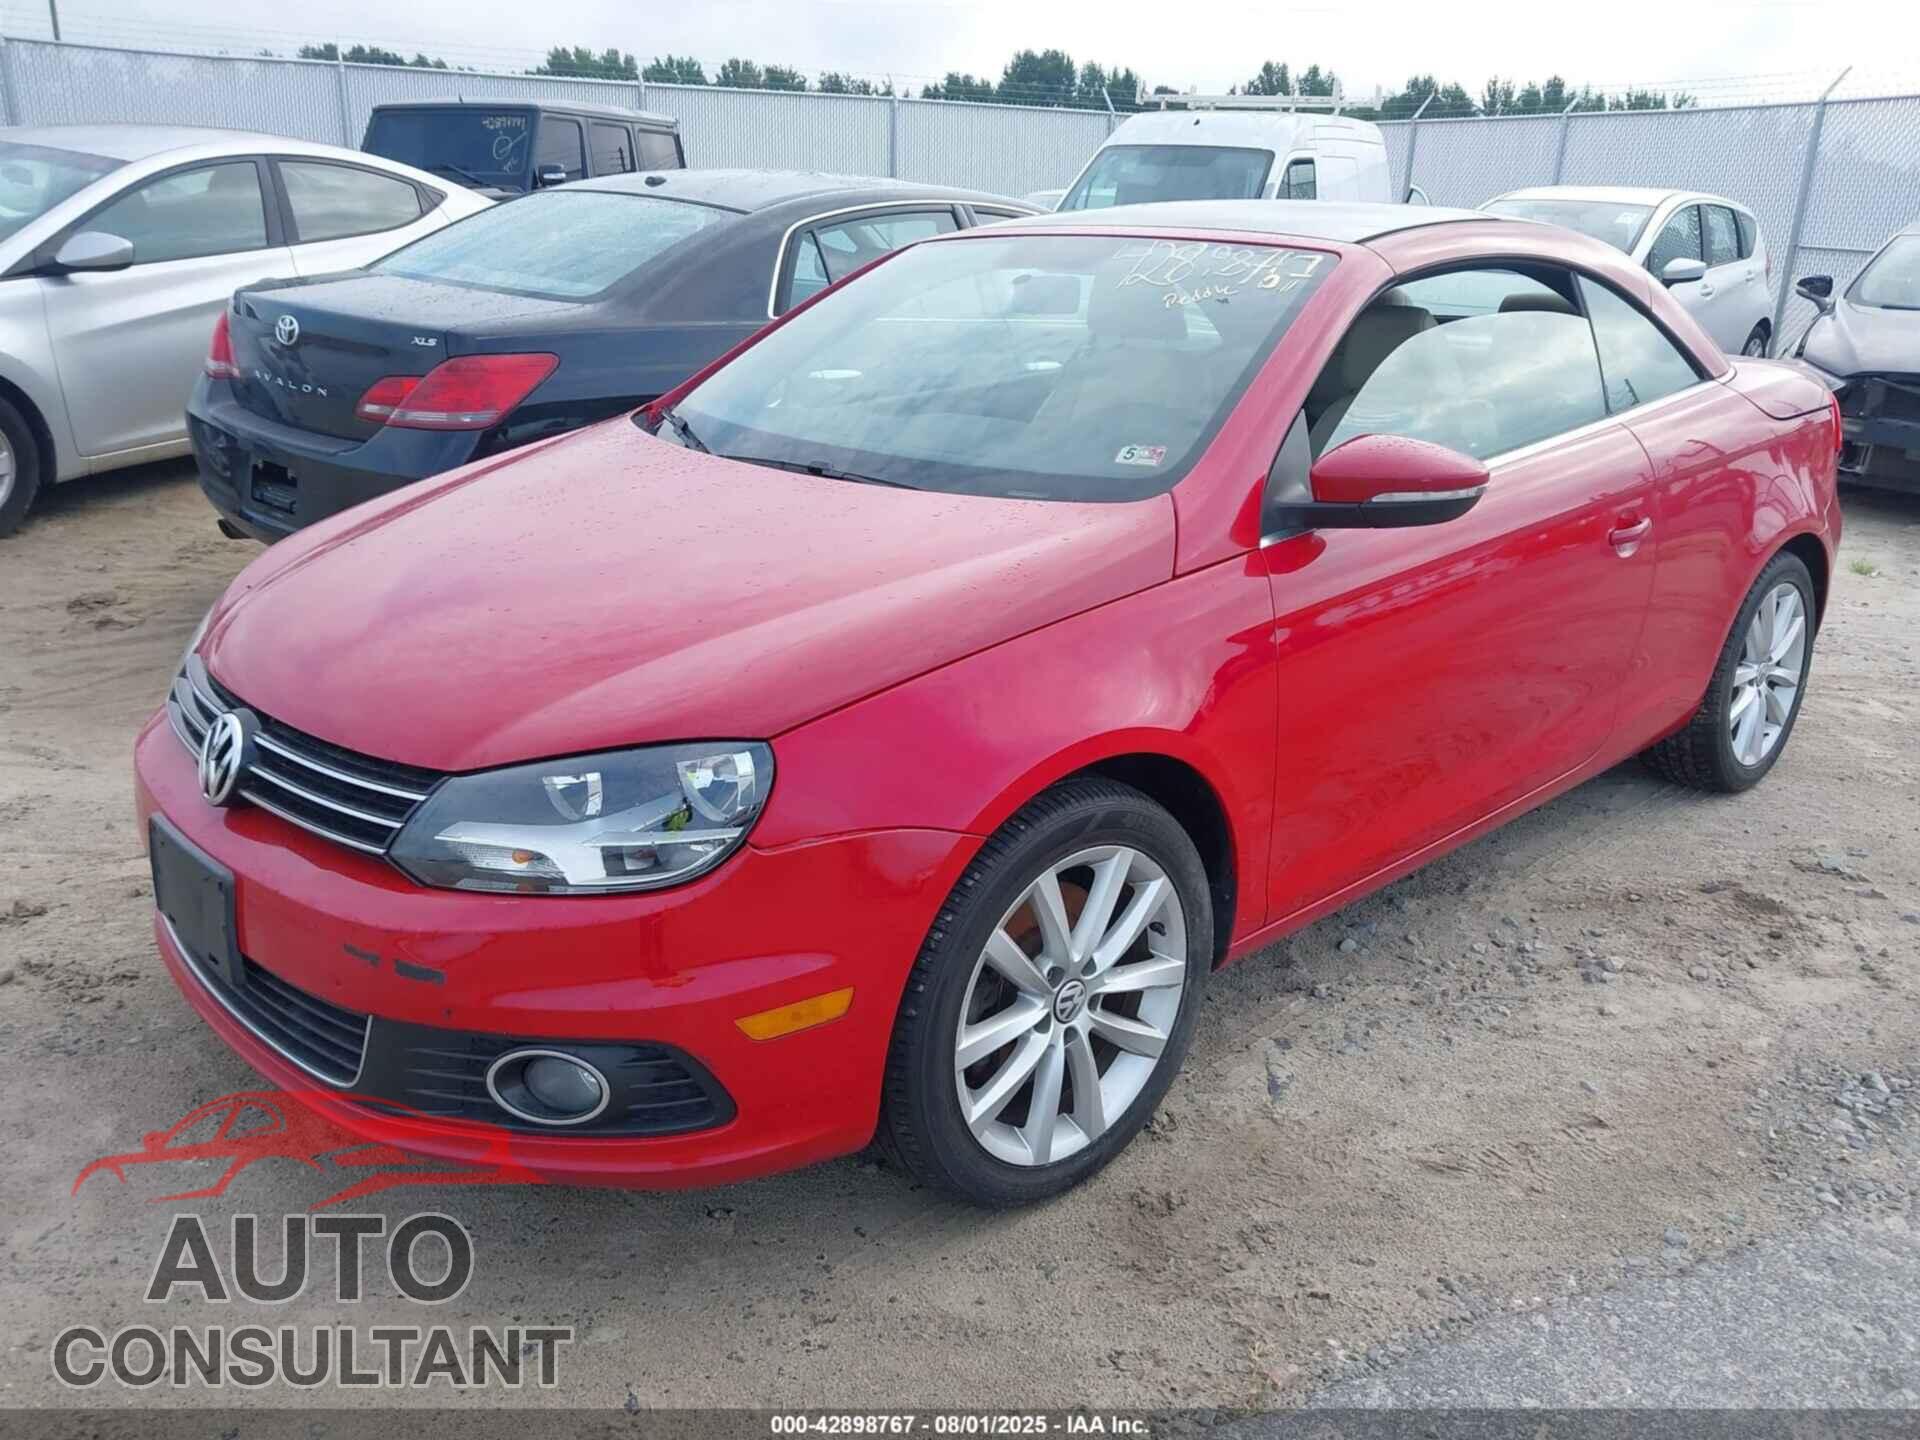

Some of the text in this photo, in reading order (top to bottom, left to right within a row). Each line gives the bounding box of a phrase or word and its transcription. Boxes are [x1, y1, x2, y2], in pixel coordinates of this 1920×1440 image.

[411, 335, 439, 347] XLS
[254, 369, 328, 398] AVALON
[1122, 447, 1138, 460] 5
